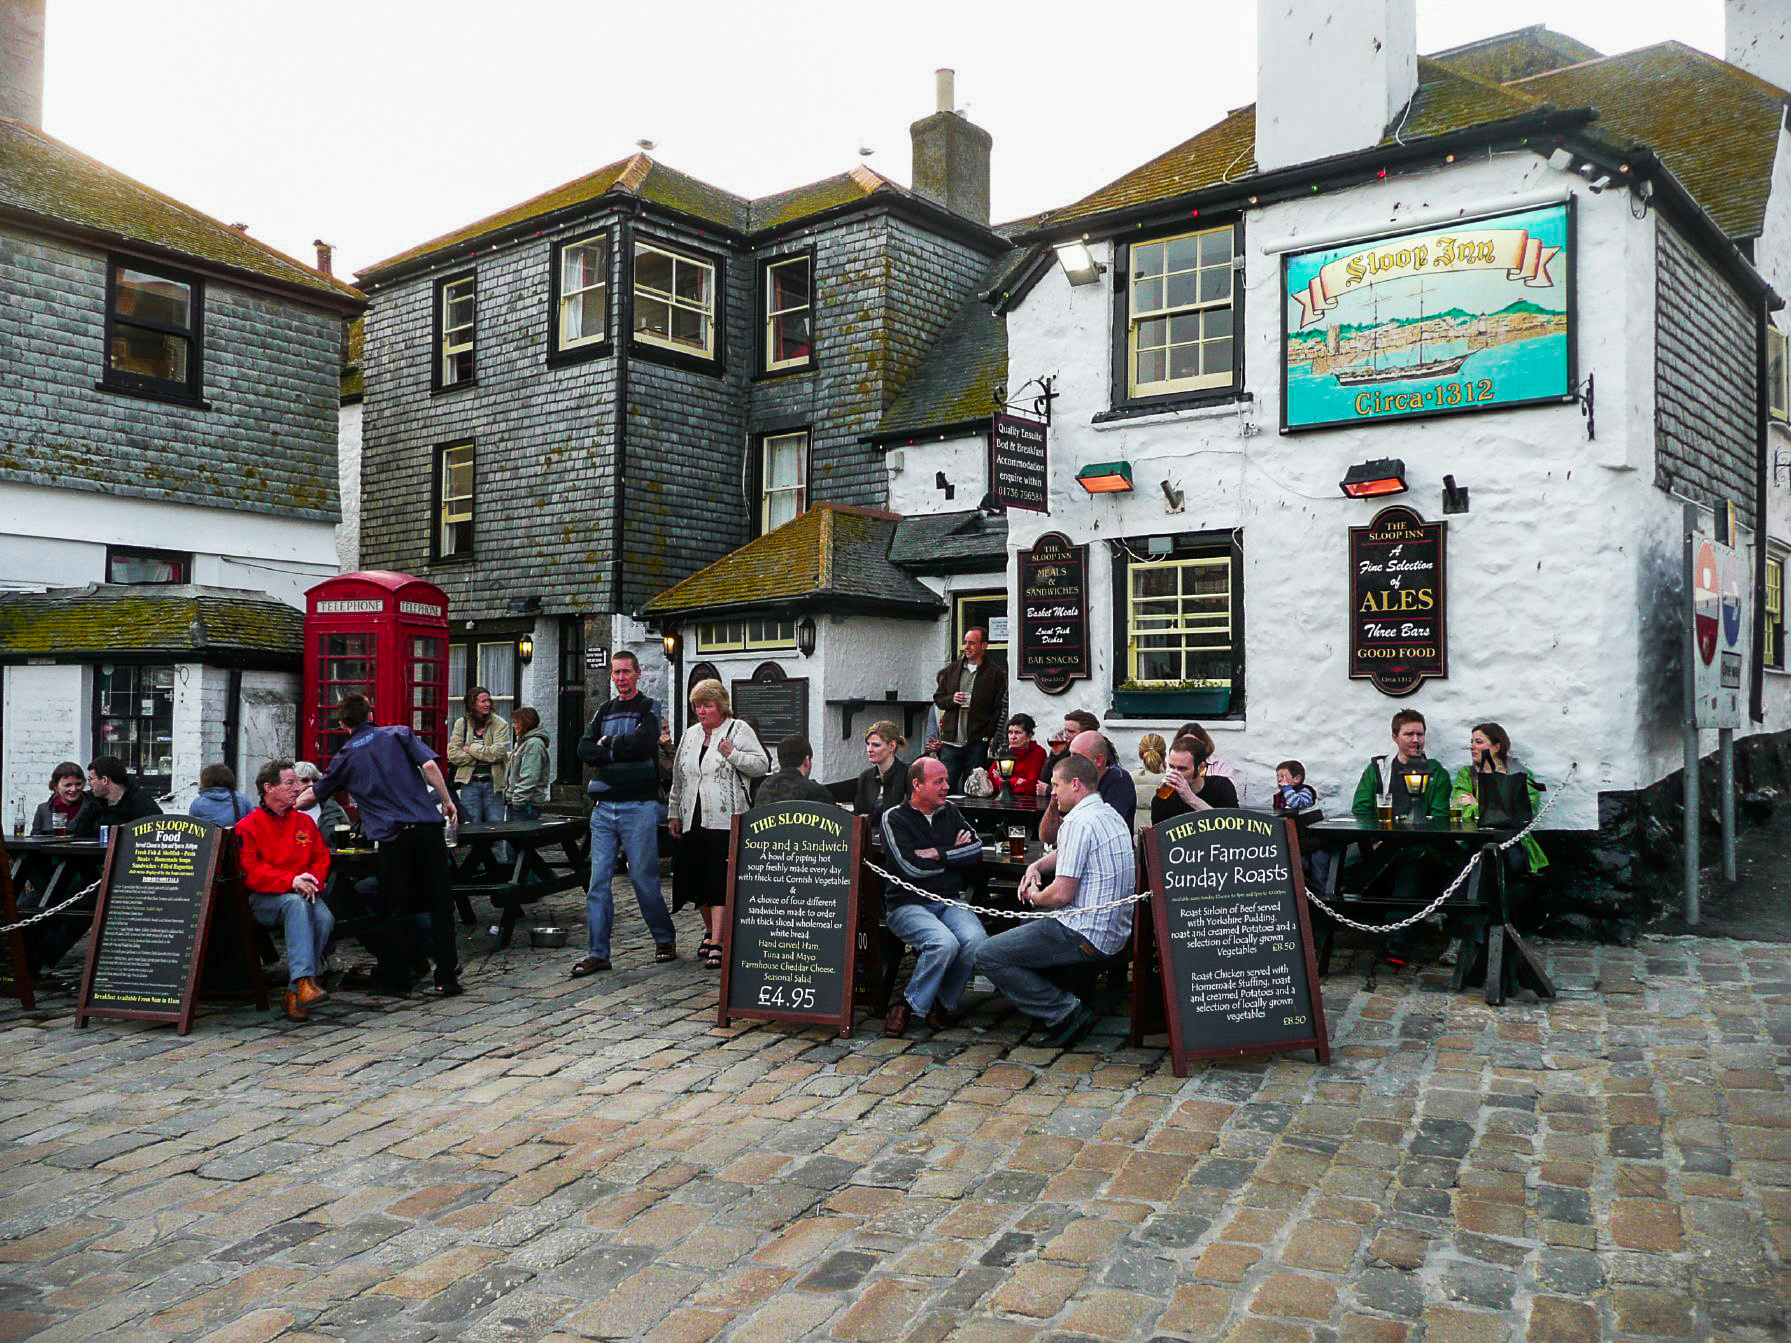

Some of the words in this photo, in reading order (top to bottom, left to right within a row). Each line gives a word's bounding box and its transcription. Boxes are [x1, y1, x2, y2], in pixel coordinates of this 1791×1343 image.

[1346, 244, 1428, 287] Sloop
[1433, 237, 1496, 267] Inn
[998, 423, 1020, 439] Quality
[1021, 429, 1043, 442] Ensuite
[996, 439, 1009, 449] Bed
[1010, 442, 1016, 451] &
[1017, 443, 1044, 457] Breakfast
[997, 454, 1045, 472] Accommodation
[1000, 473, 1023, 484] enquire
[1024, 476, 1042, 487] within
[998, 486, 1019, 498] 01736
[1387, 522, 1407, 531] THE
[1369, 531, 1402, 541] SLOOP
[1405, 530, 1424, 539] INN
[1044, 545, 1059, 553] THE
[1389, 544, 1403, 557] A
[1032, 554, 1057, 562] SLOOP
[1058, 552, 1073, 560] INN
[1037, 568, 1067, 577] MEALS
[1360, 561, 1383, 575] Fine
[1386, 560, 1434, 572] Selection
[1048, 578, 1056, 586] &
[1390, 574, 1402, 589] of
[1026, 586, 1080, 597] SANDWICHES
[321, 601, 381, 612] TELEPHONE
[1360, 589, 1434, 612] ALES
[402, 602, 441, 616] TELEPHONE
[1027, 607, 1052, 618] Basket
[1053, 607, 1079, 617] Meals
[1035, 627, 1054, 635] Local
[1055, 627, 1070, 636] Fish
[1364, 623, 1397, 638] Three
[1401, 623, 1431, 637] Bars
[1042, 636, 1063, 644] Dishes
[1358, 649, 1396, 658] GOOD
[1400, 648, 1436, 658] FOOD
[1028, 656, 1044, 664] BAR
[1046, 656, 1079, 664] SNACKS
[133, 822, 154, 837] THE
[156, 820, 189, 832] SLOOP
[188, 823, 207, 839] INN
[751, 816, 777, 834] THE
[779, 813, 819, 827] SLOOP
[819, 818, 842, 837] INN
[1166, 822, 1196, 843] THE
[1198, 817, 1245, 833] SLOOP
[1247, 819, 1273, 837] INN
[156, 831, 182, 842] Food
[745, 839, 770, 852] Soup
[772, 839, 790, 851] and
[794, 842, 799, 851] a
[802, 840, 848, 852] Sandwich
[760, 853, 767, 861] A
[768, 852, 785, 861] bowl
[787, 852, 795, 861] of
[796, 854, 817, 864] piping
[819, 854, 831, 862] hot
[1169, 847, 1205, 864] Our
[1210, 844, 1278, 863] Famous
[748, 864, 764, 873] soup
[766, 862, 788, 873] freshly
[790, 865, 808, 873] made
[809, 866, 828, 875] every
[830, 865, 842, 875] day
[739, 873, 753, 881] with
[755, 873, 772, 881] thick
[786, 875, 813, 884] Cornish
[815, 877, 851, 887] Vegetables
[1165, 867, 1228, 891] Sunday
[1234, 864, 1288, 884] Roasts
[790, 886, 797, 895] &
[757, 895, 780, 905] choice
[781, 896, 790, 905] of
[790, 896, 806, 905] four
[807, 897, 837, 907] different
[749, 906, 785, 915] sandwiches
[787, 908, 806, 916] made
[807, 908, 815, 916] to
[817, 909, 836, 918] order
[1180, 908, 1202, 918] Roast
[1203, 905, 1228, 916] Sirloin
[1230, 903, 1240, 914] of
[1240, 902, 1257, 913] Beef
[1257, 901, 1281, 912] served
[740, 916, 755, 925] with
[757, 916, 775, 926] thick
[775, 917, 795, 927] sliced
[796, 918, 833, 929] wholemeal
[1188, 917, 1204, 927] with
[1207, 915, 1242, 926] Yorkshire
[771, 928, 790, 937] white
[791, 929, 810, 939] bread
[1171, 930, 1190, 939] roast
[1191, 928, 1206, 938] and
[1207, 926, 1239, 937] creamed
[1241, 924, 1275, 935] Potatoes
[1276, 921, 1290, 931] and
[758, 939, 777, 948] Hand
[778, 940, 800, 949] carved
[1187, 939, 1221, 948] selection
[1222, 935, 1232, 945] of
[1233, 934, 1258, 945] locally
[1259, 935, 1284, 945] grown
[1272, 941, 1295, 951] £8.50
[763, 951, 780, 959] Tuna
[781, 951, 795, 960] and
[796, 953, 817, 963] Mayo
[1217, 945, 1257, 958] Vegetables
[742, 960, 779, 970] Farmhouse
[780, 962, 809, 972] Cheddar
[1191, 971, 1212, 981] Roast
[1214, 969, 1245, 979] Chicken
[1246, 966, 1270, 976] served
[1272, 963, 1289, 974] with
[764, 972, 793, 981] Seasonal
[794, 974, 812, 984] Salad
[1191, 980, 1236, 991] Homemade
[1238, 976, 1270, 988] Stuffing,
[1272, 976, 1291, 985] roast
[758, 986, 816, 1008] £4.95
[1190, 992, 1205, 1003] and
[1206, 991, 1239, 1002] creamed
[1241, 989, 1274, 998] Potatoes
[1275, 985, 1289, 995] and
[1196, 1003, 1230, 1013] selection
[1232, 999, 1242, 1009] of
[1242, 998, 1267, 1010] locally
[1269, 998, 1294, 1009] grown
[1226, 1009, 1266, 1023] vegetables
[1283, 1015, 1307, 1026] £8.50
